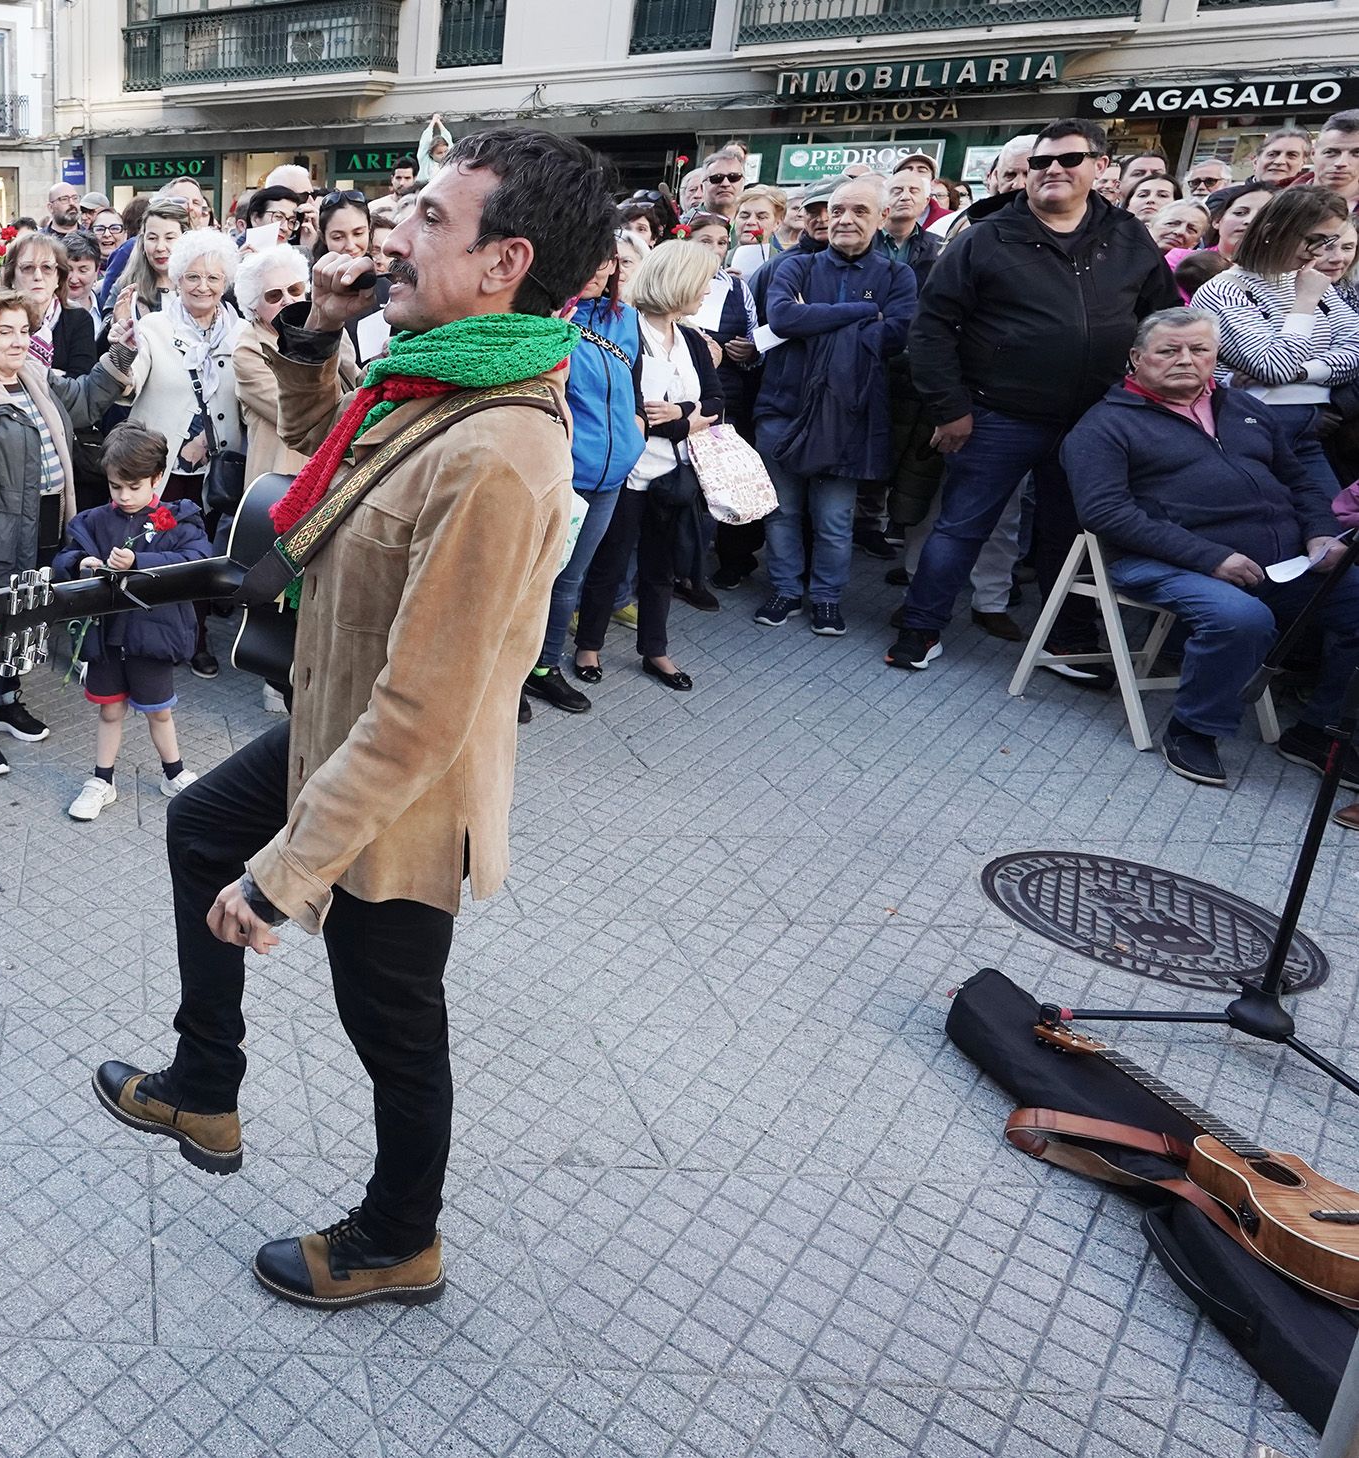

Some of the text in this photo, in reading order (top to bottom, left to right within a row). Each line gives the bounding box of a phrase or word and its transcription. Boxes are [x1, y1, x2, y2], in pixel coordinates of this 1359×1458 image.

[776, 55, 1057, 95] INMOBILIARIA
[1128, 81, 1342, 112] AGASALLO
[800, 101, 959, 124] PEDROSA
[121, 159, 201, 177] ARESSO
[347, 152, 414, 170] ARE
